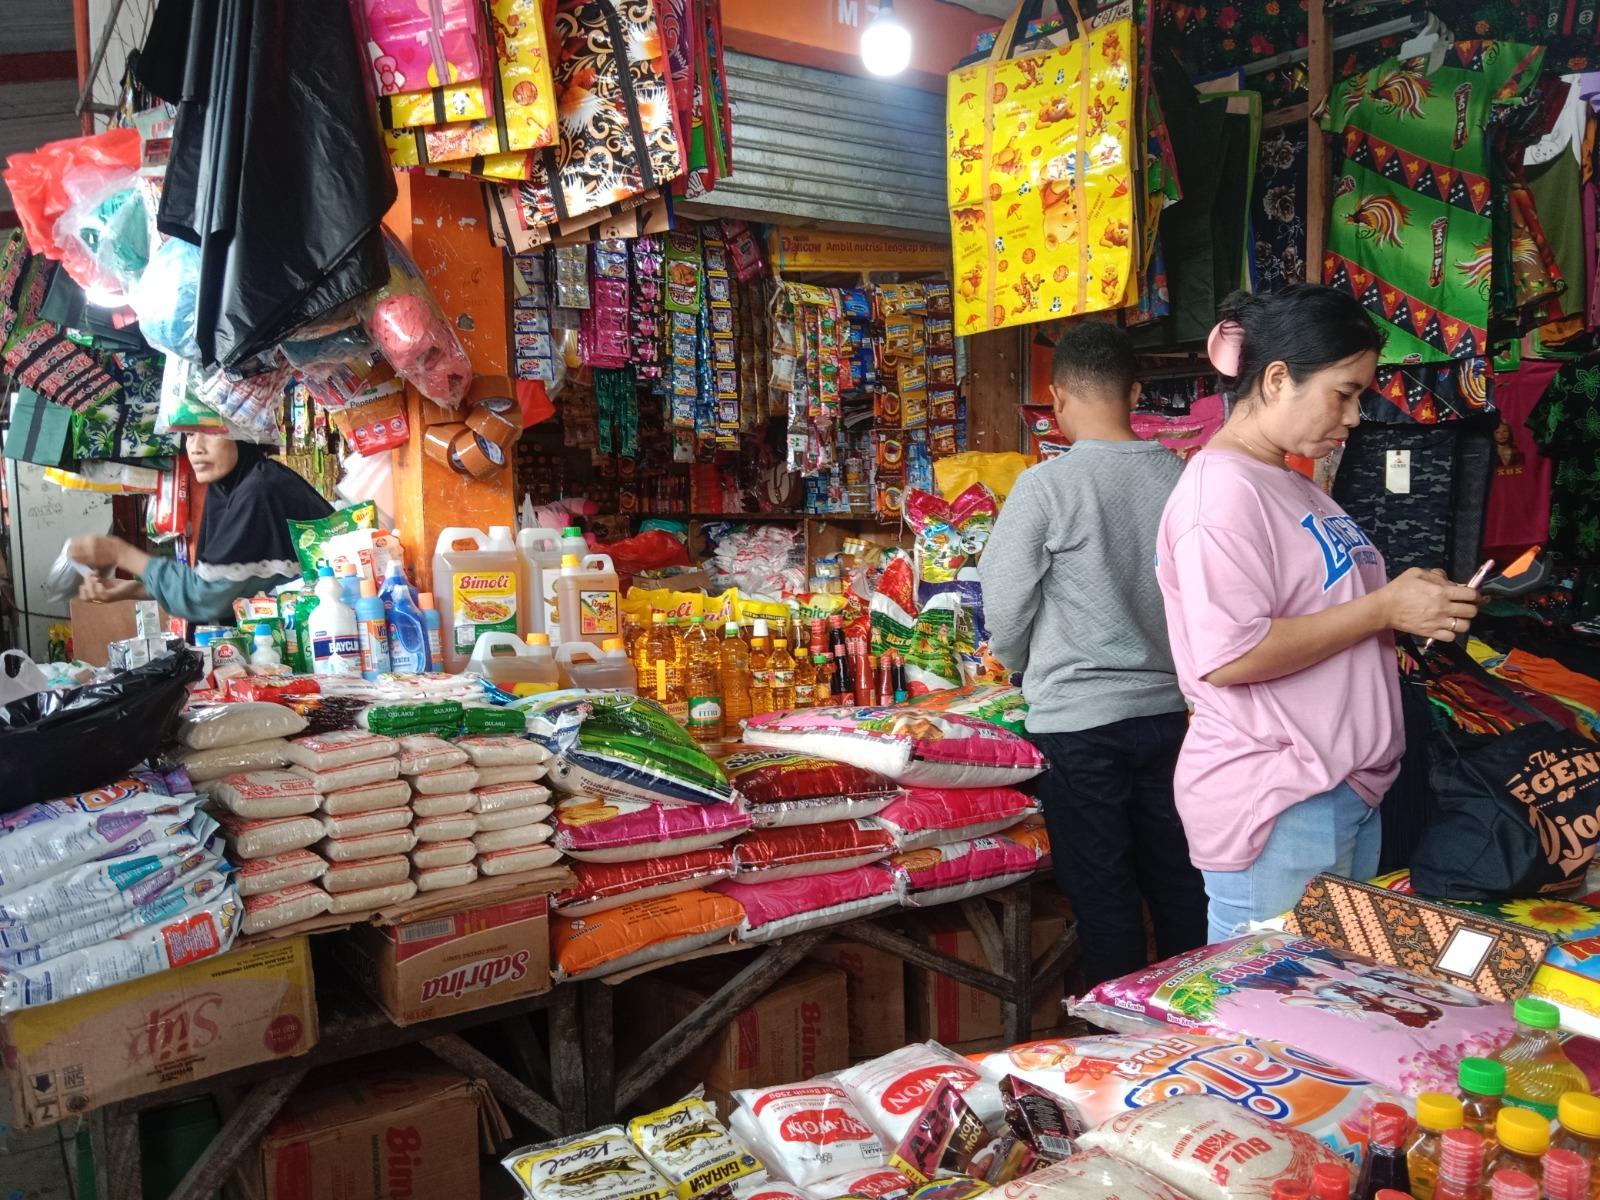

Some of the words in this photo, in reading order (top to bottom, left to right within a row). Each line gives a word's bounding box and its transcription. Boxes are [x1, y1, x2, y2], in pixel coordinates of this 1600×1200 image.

[350, 393, 390, 409] Pepsodent
[459, 575, 510, 591] Bimoli
[329, 641, 360, 653] BAYCLI
[1505, 751, 1600, 804] EGEN
[420, 951, 531, 1002] Sabrina
[386, 1126, 422, 1200] Bim
[539, 1142, 609, 1176] Kapal
[689, 1160, 742, 1194] GARAM
